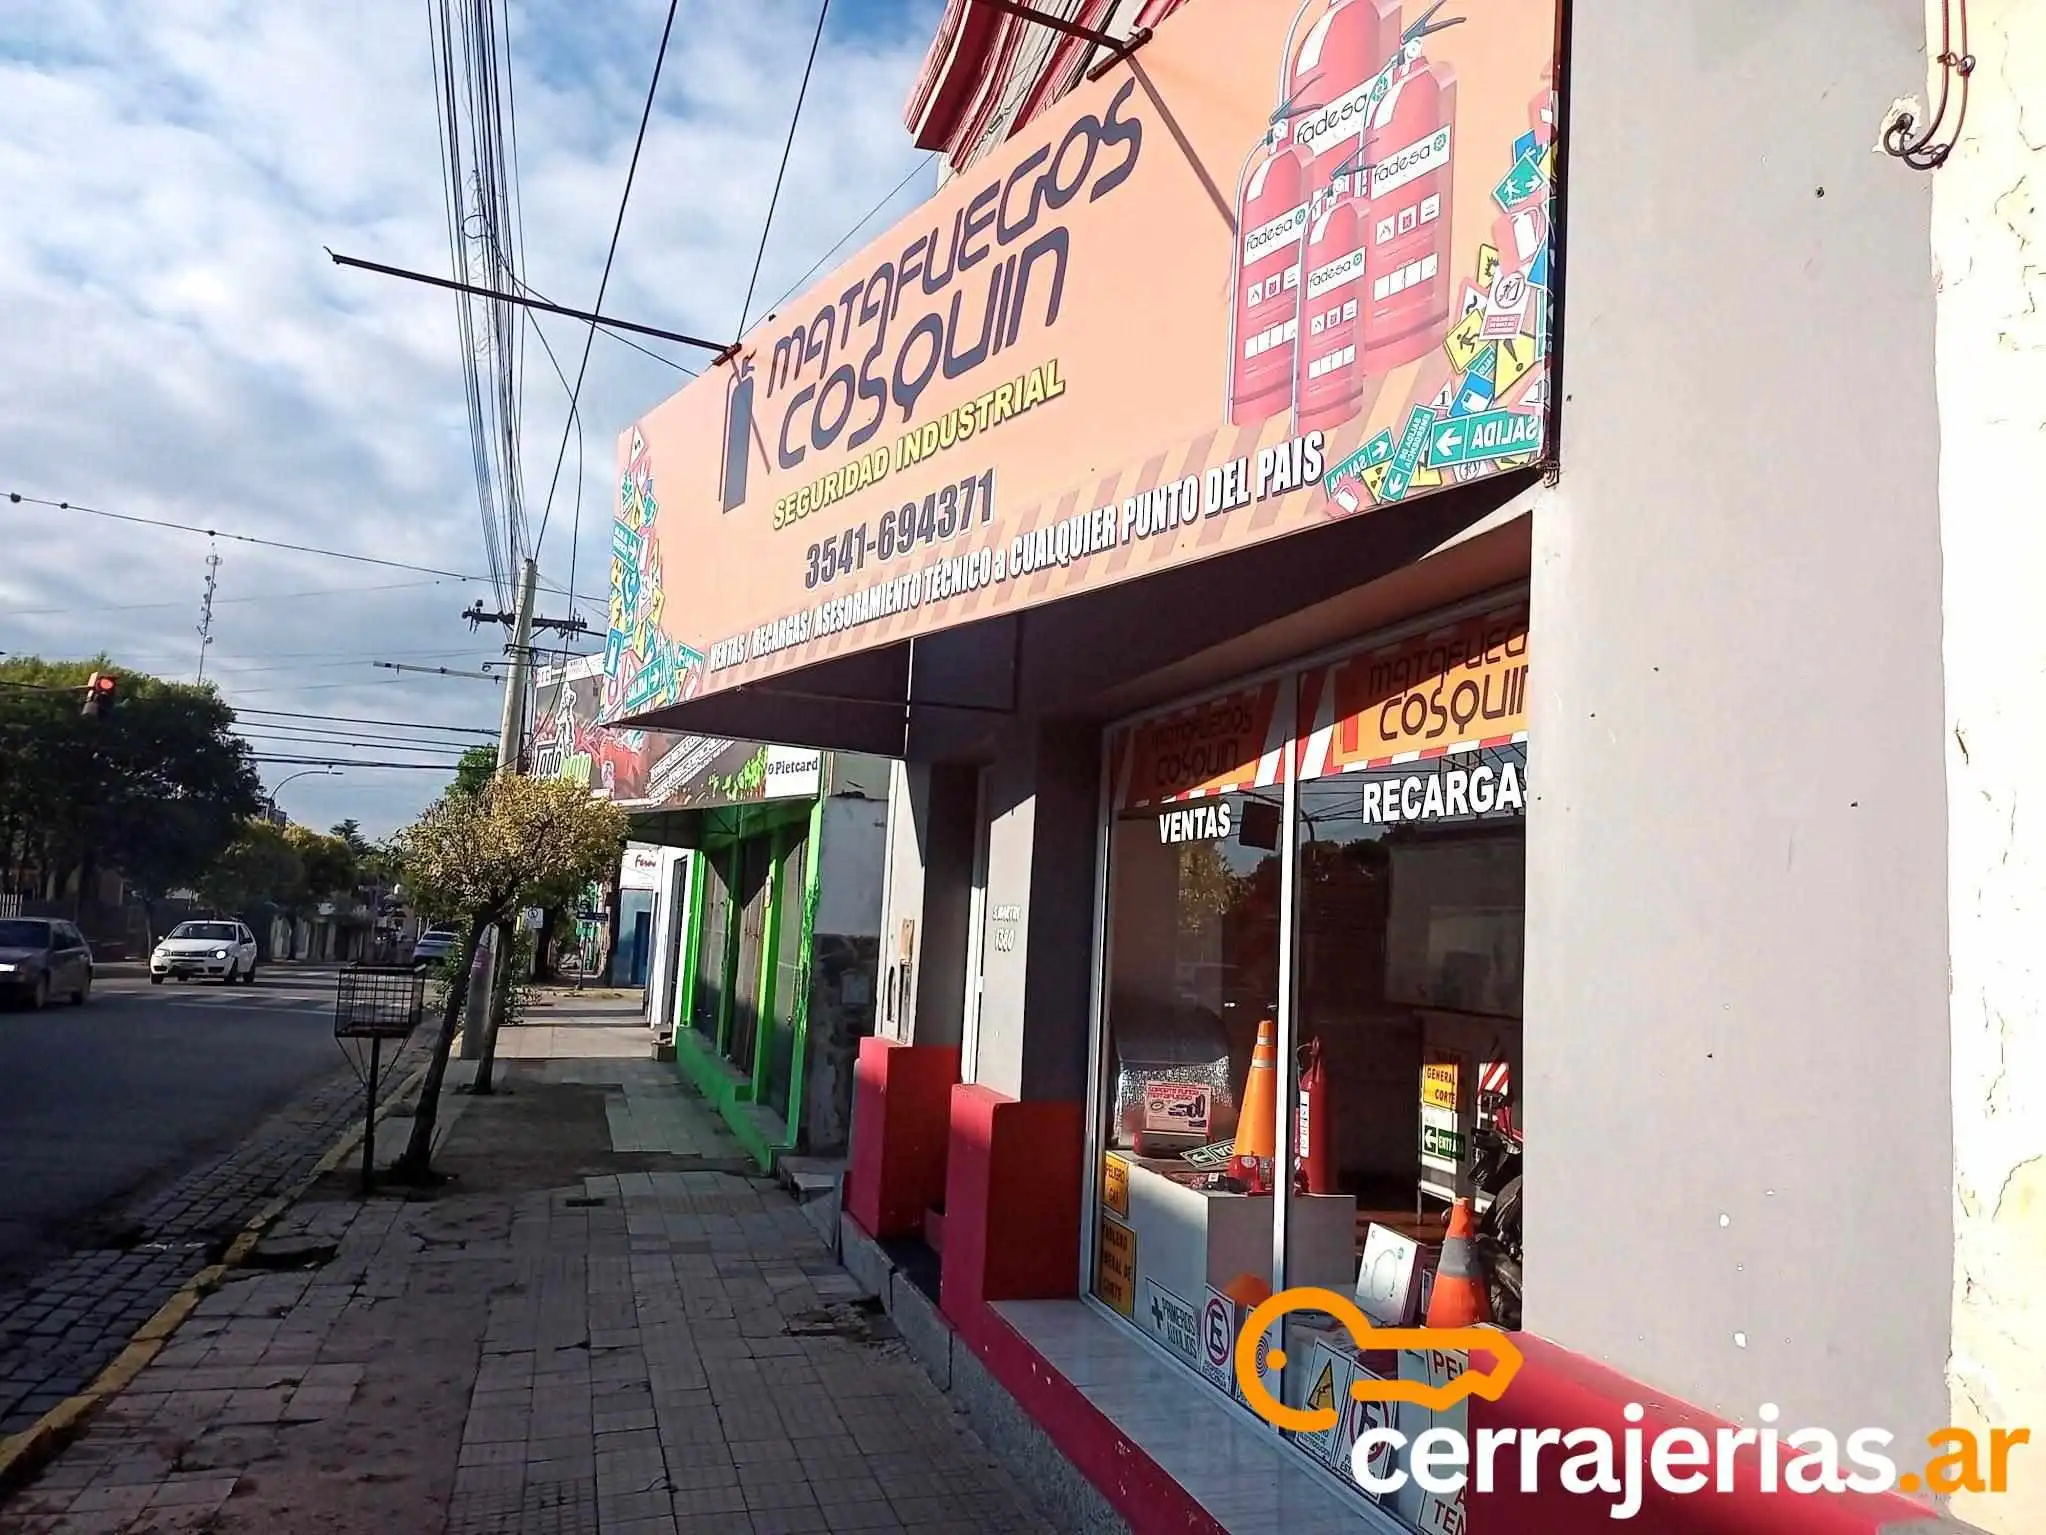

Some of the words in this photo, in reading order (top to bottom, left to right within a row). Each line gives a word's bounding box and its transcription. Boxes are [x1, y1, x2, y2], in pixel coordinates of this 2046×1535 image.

[1296, 93, 1367, 144] fadesa
[1374, 143, 1430, 184] fadesa
[767, 77, 1142, 398] MATAFUEGOS
[1246, 218, 1293, 252] fadesa
[1309, 260, 1351, 289] fadesa
[777, 226, 1069, 470] COSQUIN
[772, 446, 890, 531] SEGURIDAD
[895, 360, 1066, 472] INDUSTRIAL
[805, 469, 995, 591] 3541-694371
[709, 633, 746, 674] VENTAS
[752, 607, 809, 659] RECARGAS
[814, 572, 922, 640] ASESORAMIENTO
[924, 546, 992, 605] TÉCNICO
[994, 549, 1007, 583] a
[1009, 512, 1117, 578] CUALQUIER
[1122, 474, 1200, 545] PUNTO
[1203, 456, 1251, 519] DEL
[775, 756, 818, 775] Pietcard
[1362, 762, 1528, 825] RECARGA
[1159, 803, 1232, 844] VENTAS
